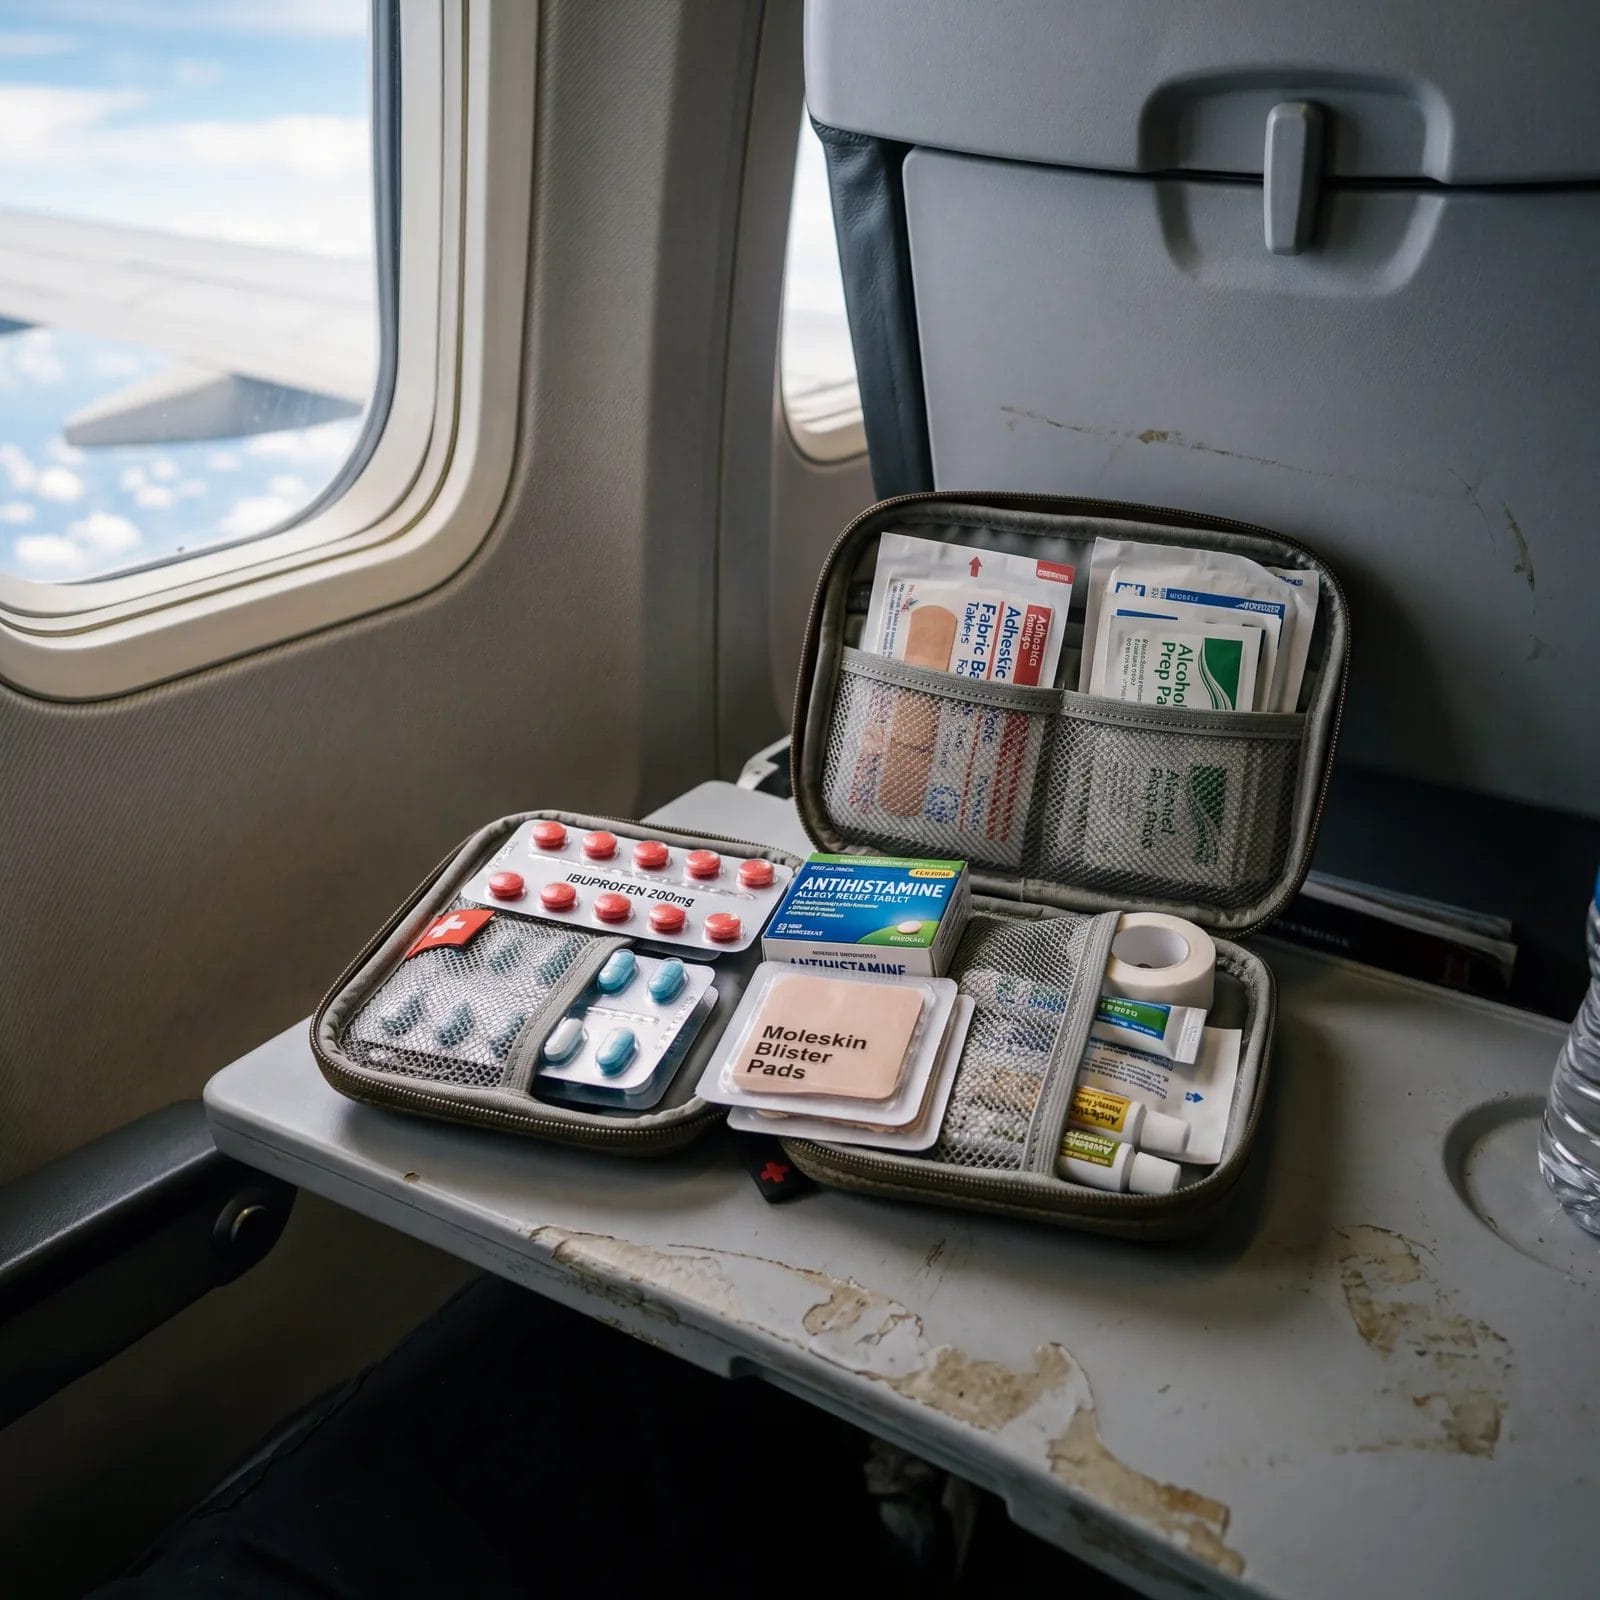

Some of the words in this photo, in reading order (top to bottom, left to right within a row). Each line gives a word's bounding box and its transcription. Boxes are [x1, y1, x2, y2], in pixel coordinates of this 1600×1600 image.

[974, 603, 997, 656] Fabric
[1154, 641, 1176, 681] Prep
[1172, 643, 1194, 708] Alcohol
[566, 873, 647, 897] IBUPROFEN
[647, 888, 696, 908] 200mg
[800, 877, 946, 898] ANTIHISTAMINE
[836, 893, 871, 901] RELIEF
[762, 1025, 868, 1050] Moleskin
[755, 1041, 833, 1064] Blister
[746, 1059, 806, 1080] Pads
